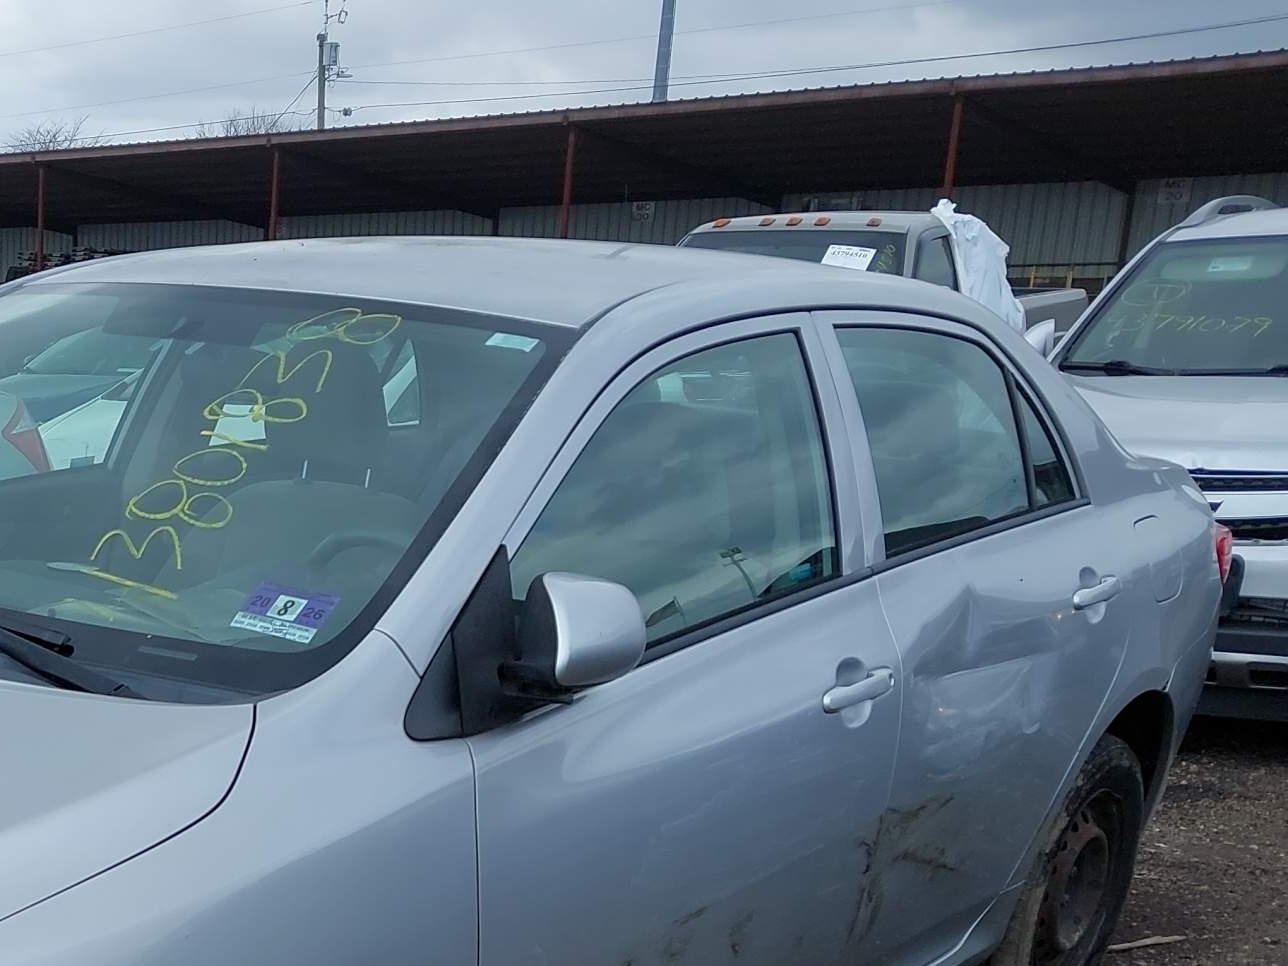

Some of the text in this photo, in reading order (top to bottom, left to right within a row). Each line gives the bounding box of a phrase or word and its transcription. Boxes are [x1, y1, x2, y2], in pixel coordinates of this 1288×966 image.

[251, 595, 325, 620] 20 8 26
